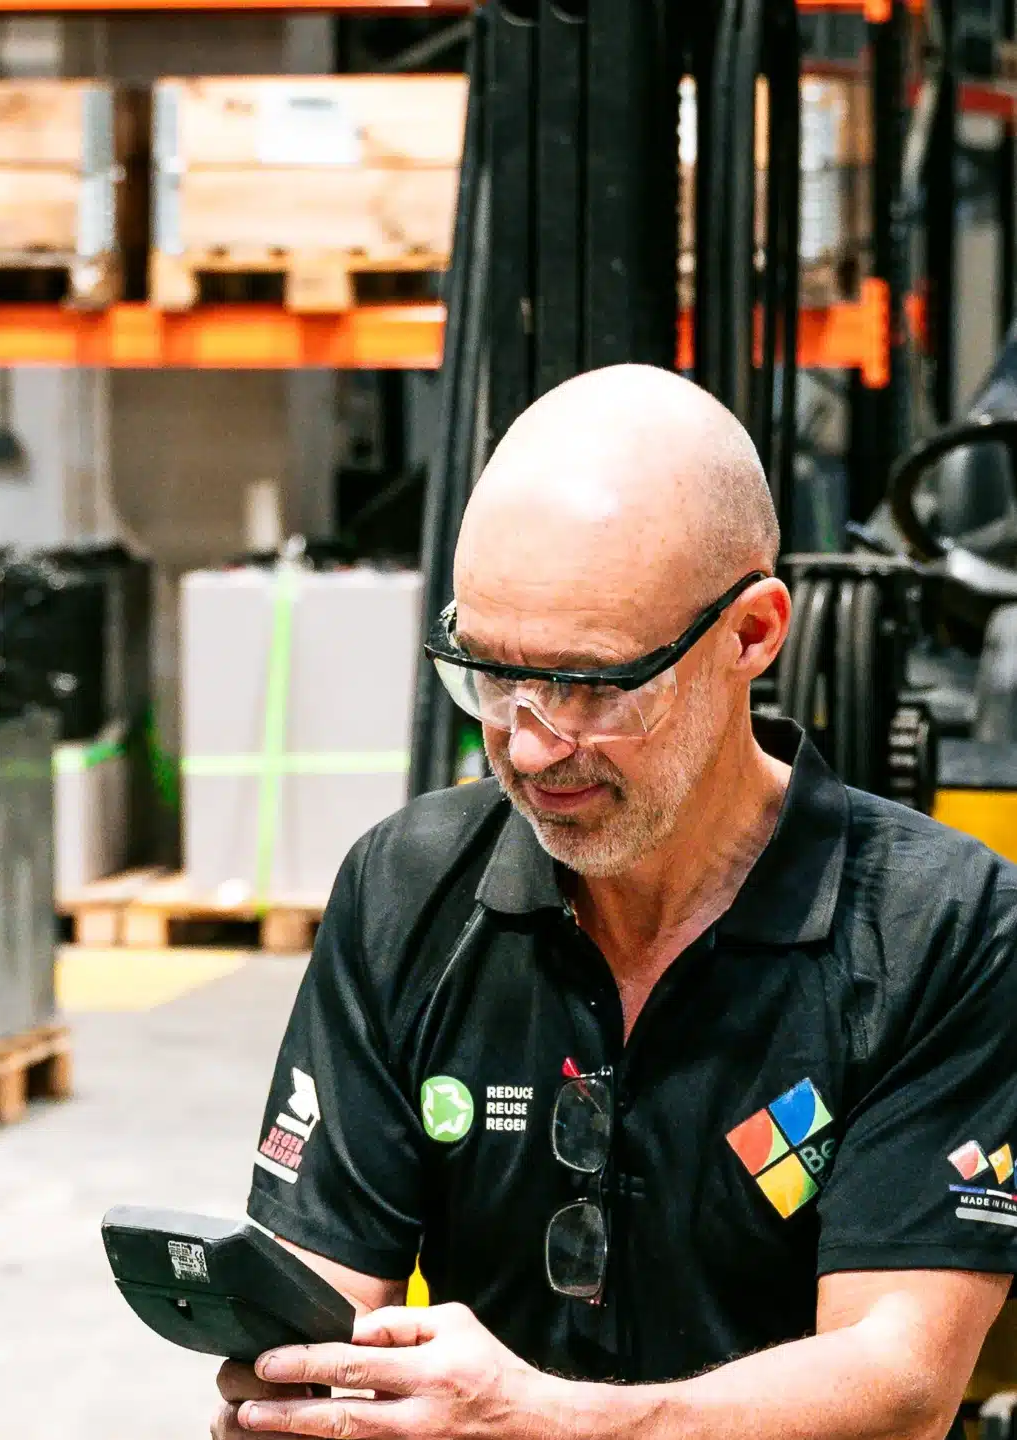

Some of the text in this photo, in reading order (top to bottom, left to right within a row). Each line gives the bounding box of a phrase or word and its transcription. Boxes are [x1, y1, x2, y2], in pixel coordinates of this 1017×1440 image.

[486, 1086, 534, 1100] REDUCE
[486, 1102, 528, 1115] REUSE
[485, 1117, 527, 1131] REGEN
[960, 1195, 990, 1207] MADE
[991, 1199, 1001, 1208] IN
